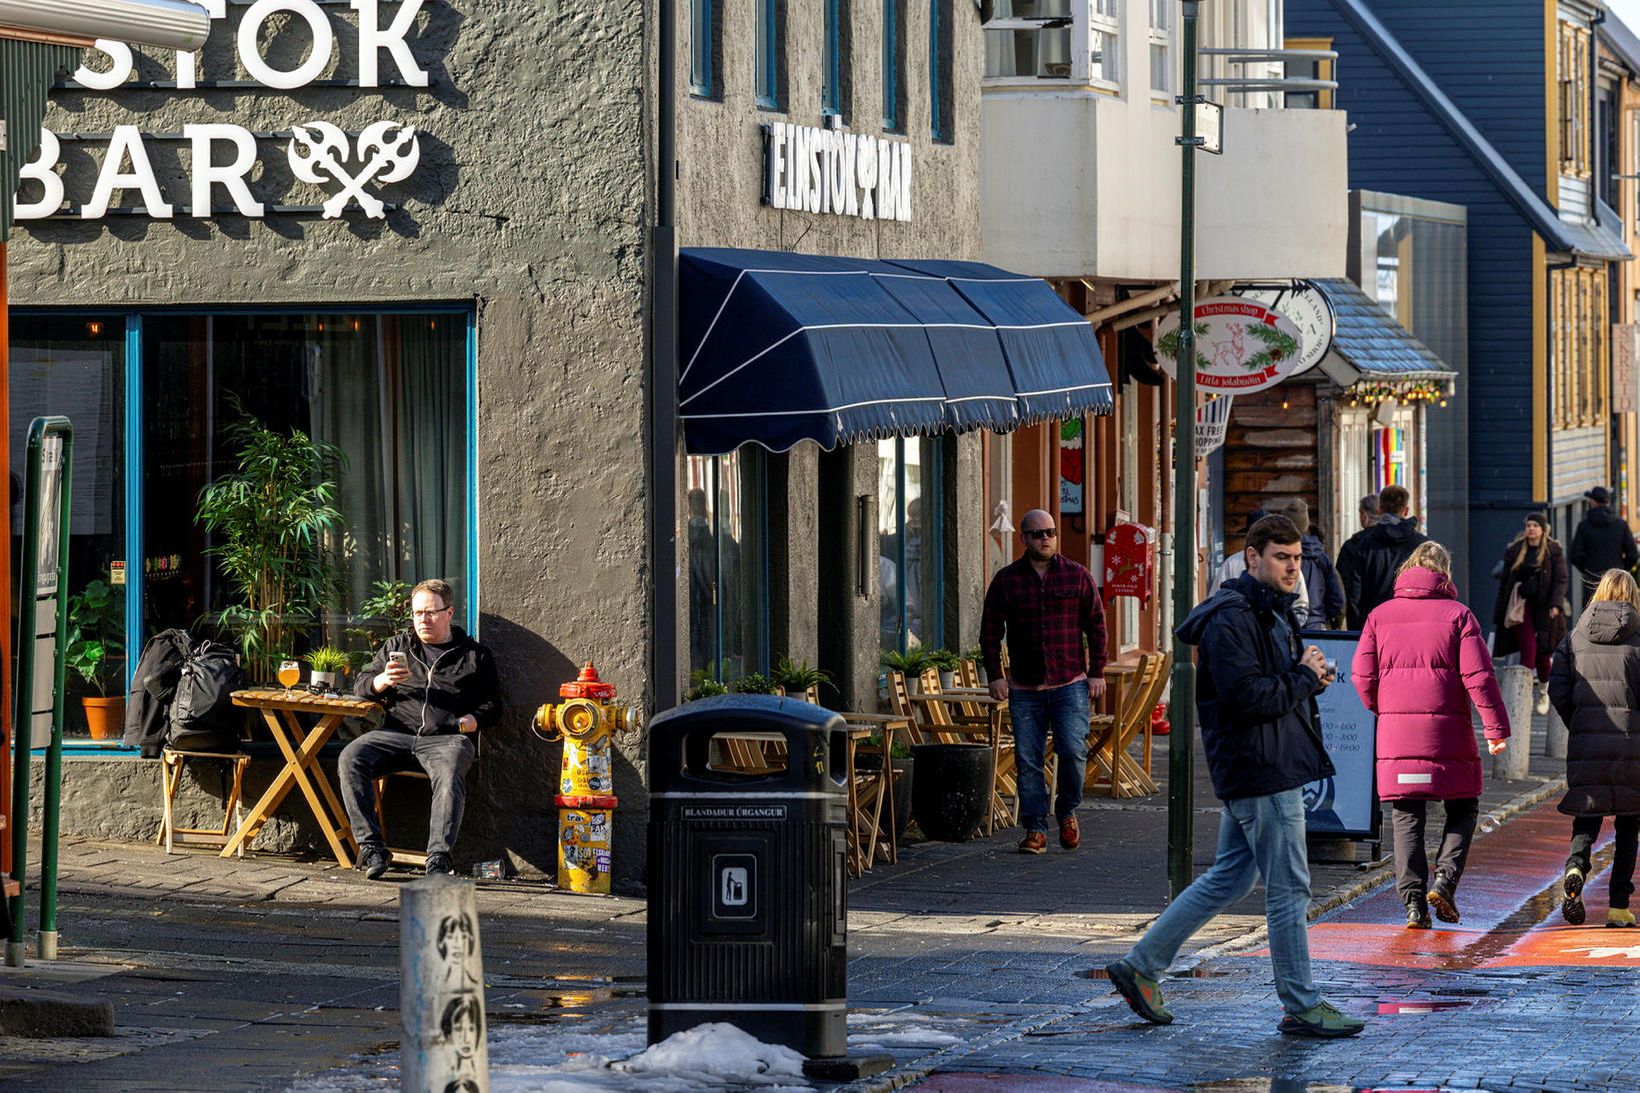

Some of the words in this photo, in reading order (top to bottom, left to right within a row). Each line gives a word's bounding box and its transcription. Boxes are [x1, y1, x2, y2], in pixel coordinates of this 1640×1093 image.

[13, 123, 265, 219] BAR
[878, 138, 912, 221] BAR
[1206, 425, 1224, 436] FREE
